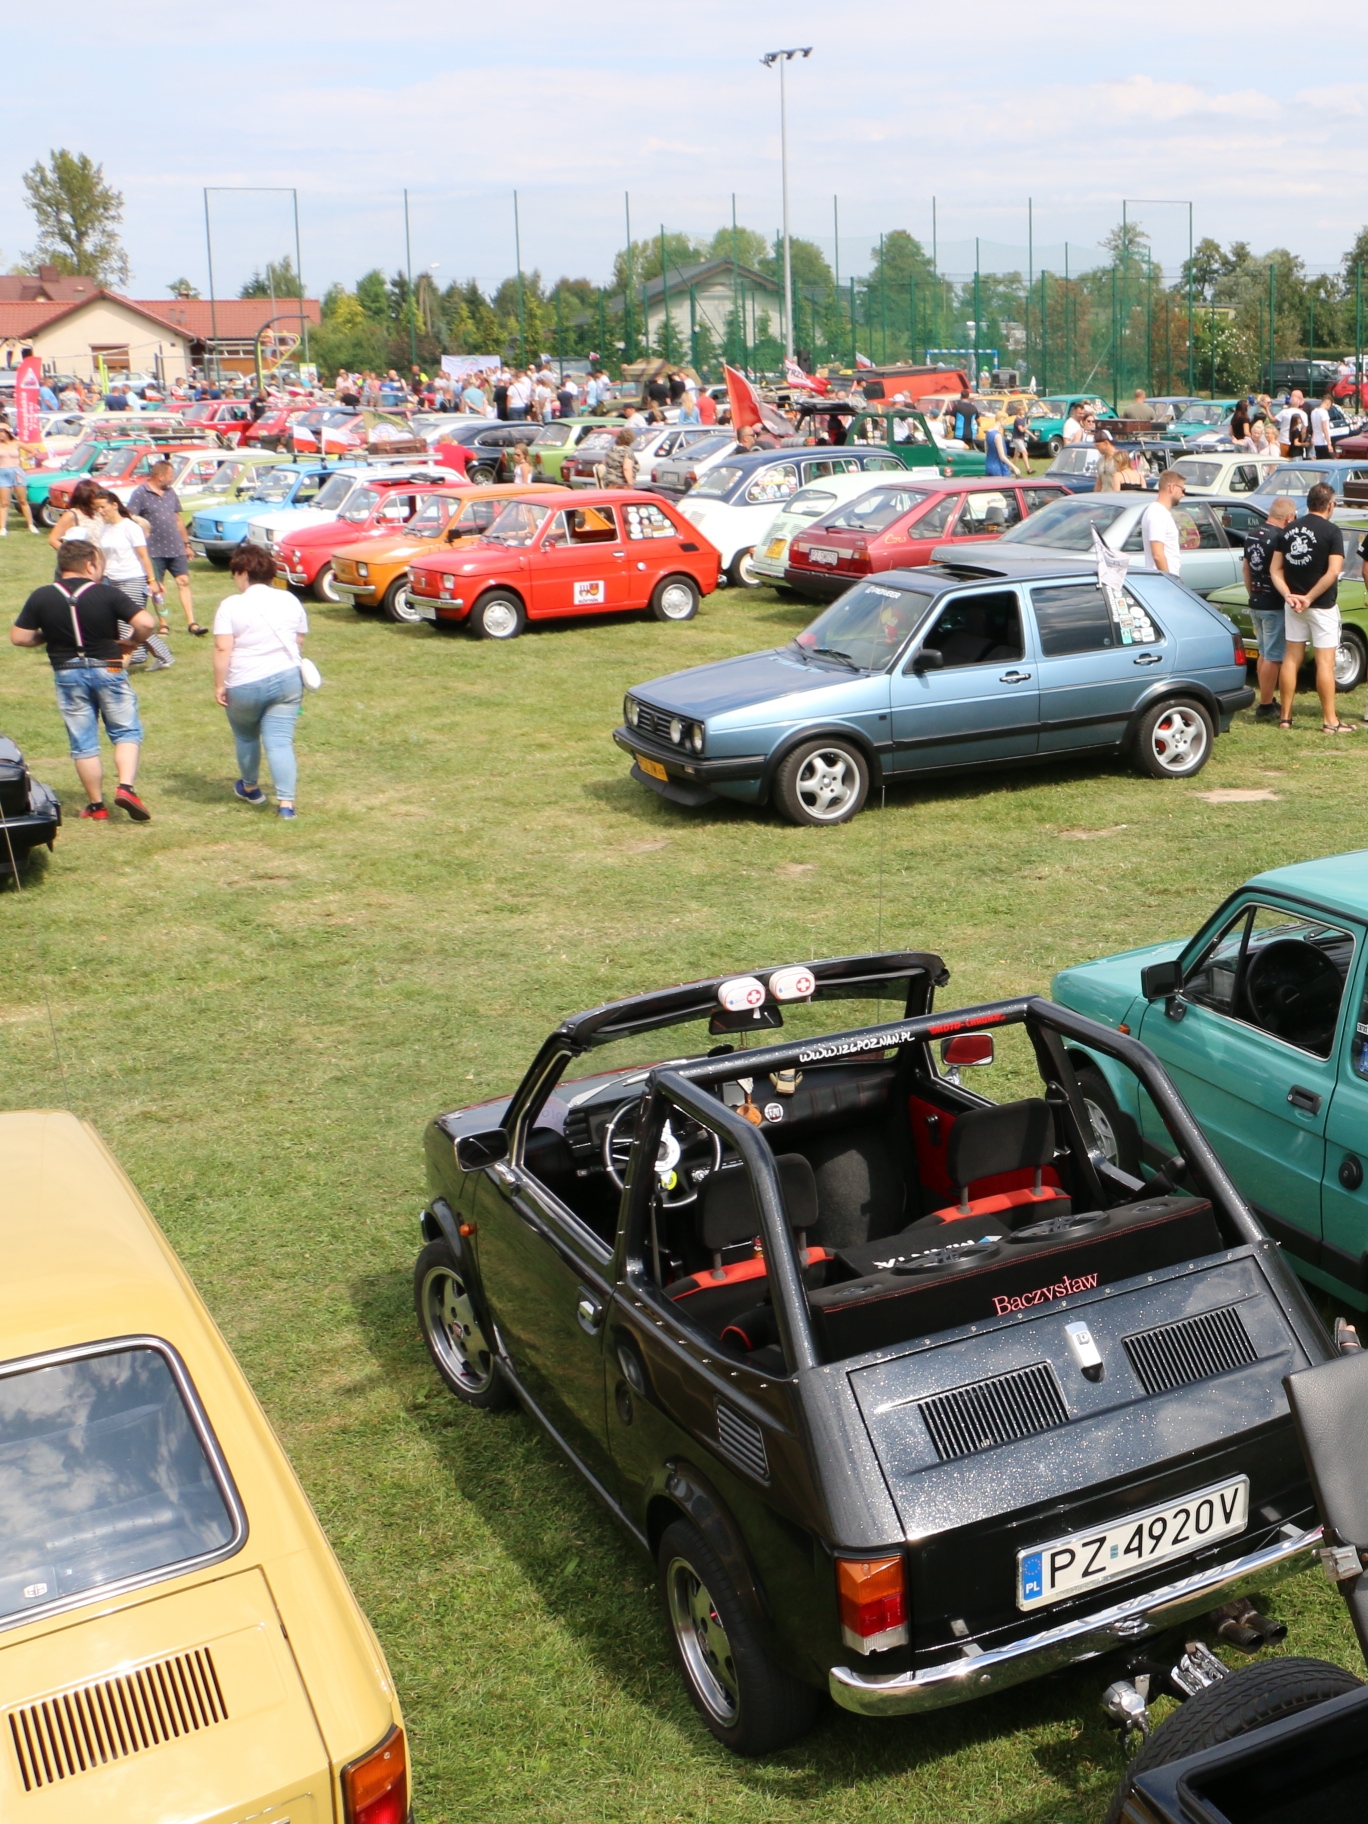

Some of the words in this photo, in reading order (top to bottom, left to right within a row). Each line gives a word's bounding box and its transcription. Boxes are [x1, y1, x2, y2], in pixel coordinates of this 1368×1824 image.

[992, 1272, 1098, 1317] Baczysław
[1050, 1536, 1107, 1589] PZ
[1123, 1487, 1239, 1559] 4920V
[1025, 1581, 1040, 1595] PL
